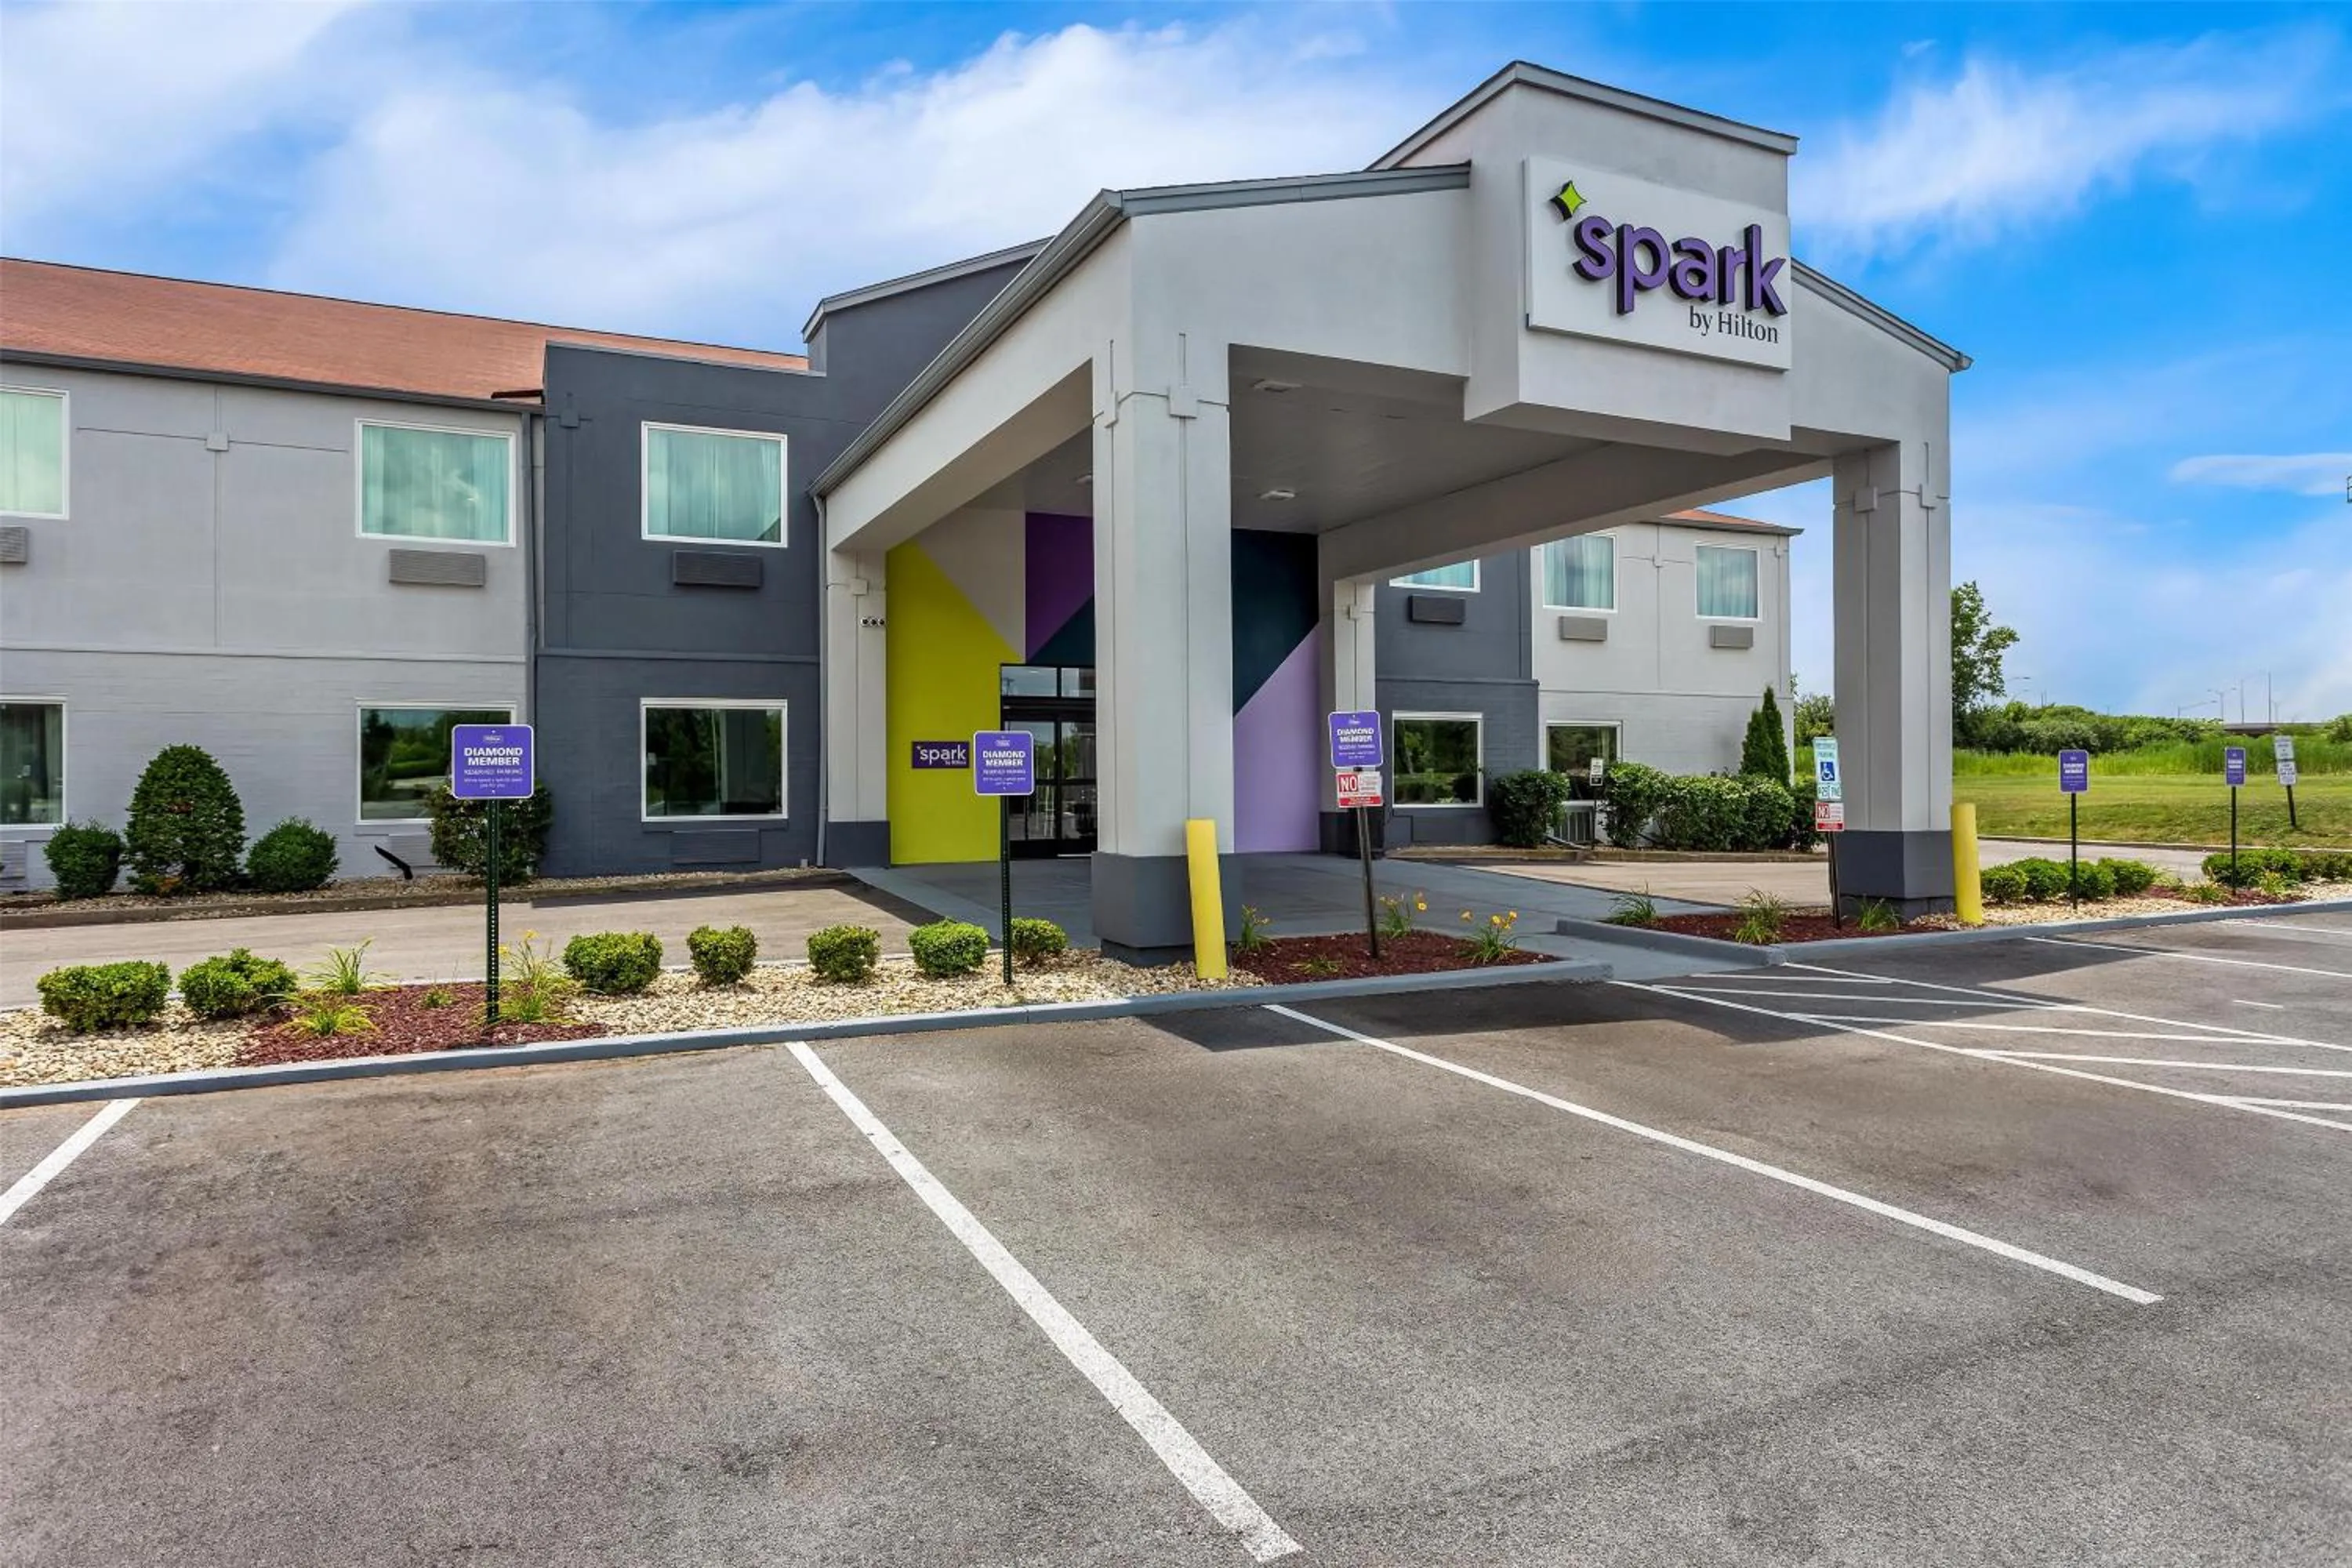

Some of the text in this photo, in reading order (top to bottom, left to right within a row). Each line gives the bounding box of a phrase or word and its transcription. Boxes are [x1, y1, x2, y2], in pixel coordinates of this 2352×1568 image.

[1572, 215, 1788, 316] spark
[1689, 305, 1779, 343] by Hilton
[463, 747, 523, 757] DIAMOND
[919, 744, 967, 765] spark
[468, 757, 520, 766] MEMBER
[1341, 776, 1357, 792] NO
